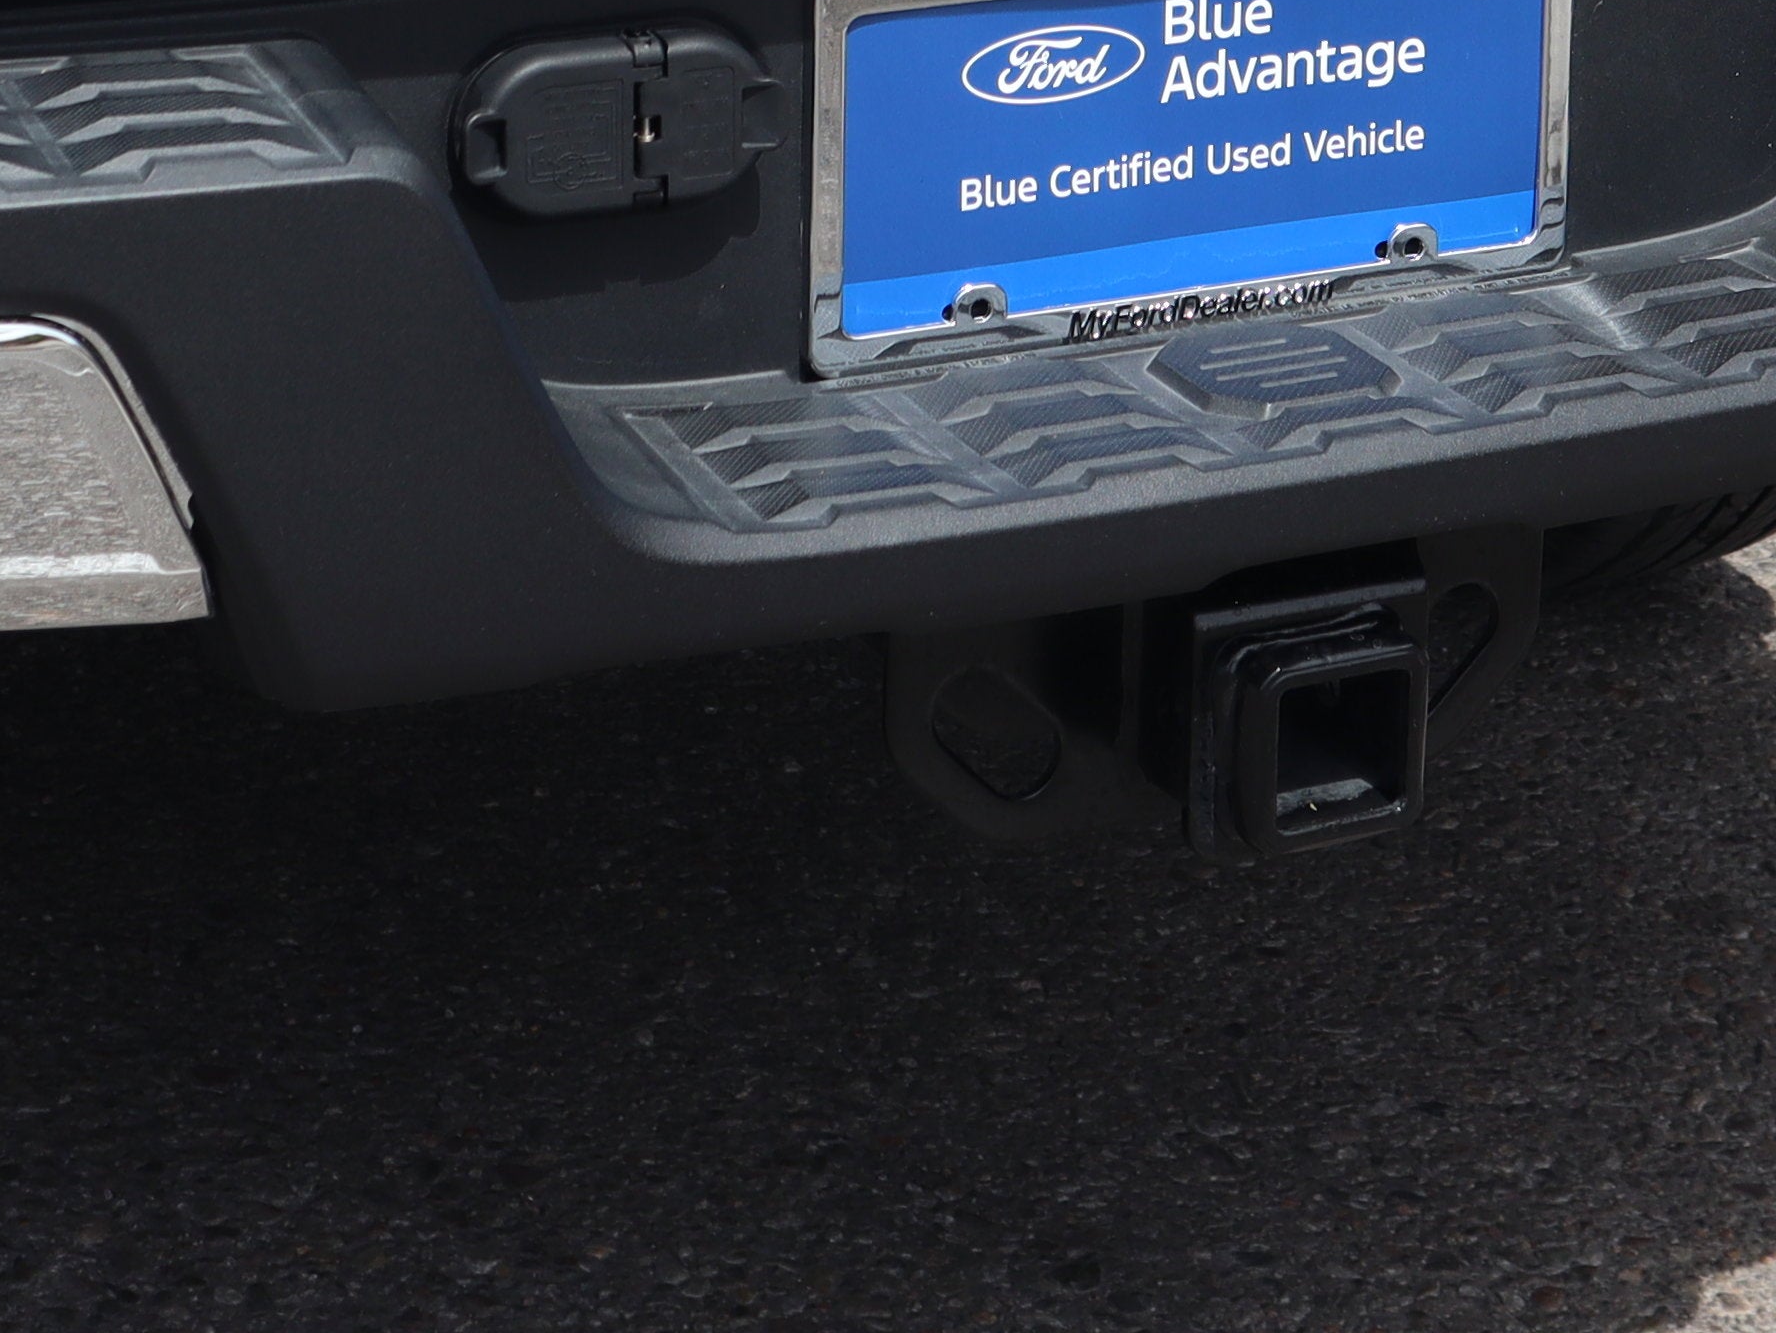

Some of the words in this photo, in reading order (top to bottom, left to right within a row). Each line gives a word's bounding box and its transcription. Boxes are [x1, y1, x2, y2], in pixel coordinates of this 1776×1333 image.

[997, 36, 1110, 94] Ford
[1160, 36, 1426, 104] Advantage
[960, 173, 1039, 212] Blue
[1050, 146, 1194, 199] Certified
[1206, 132, 1292, 175] Used
[1304, 119, 1425, 163] Vehicle
[1067, 280, 1333, 343] MyFordDealer.com
